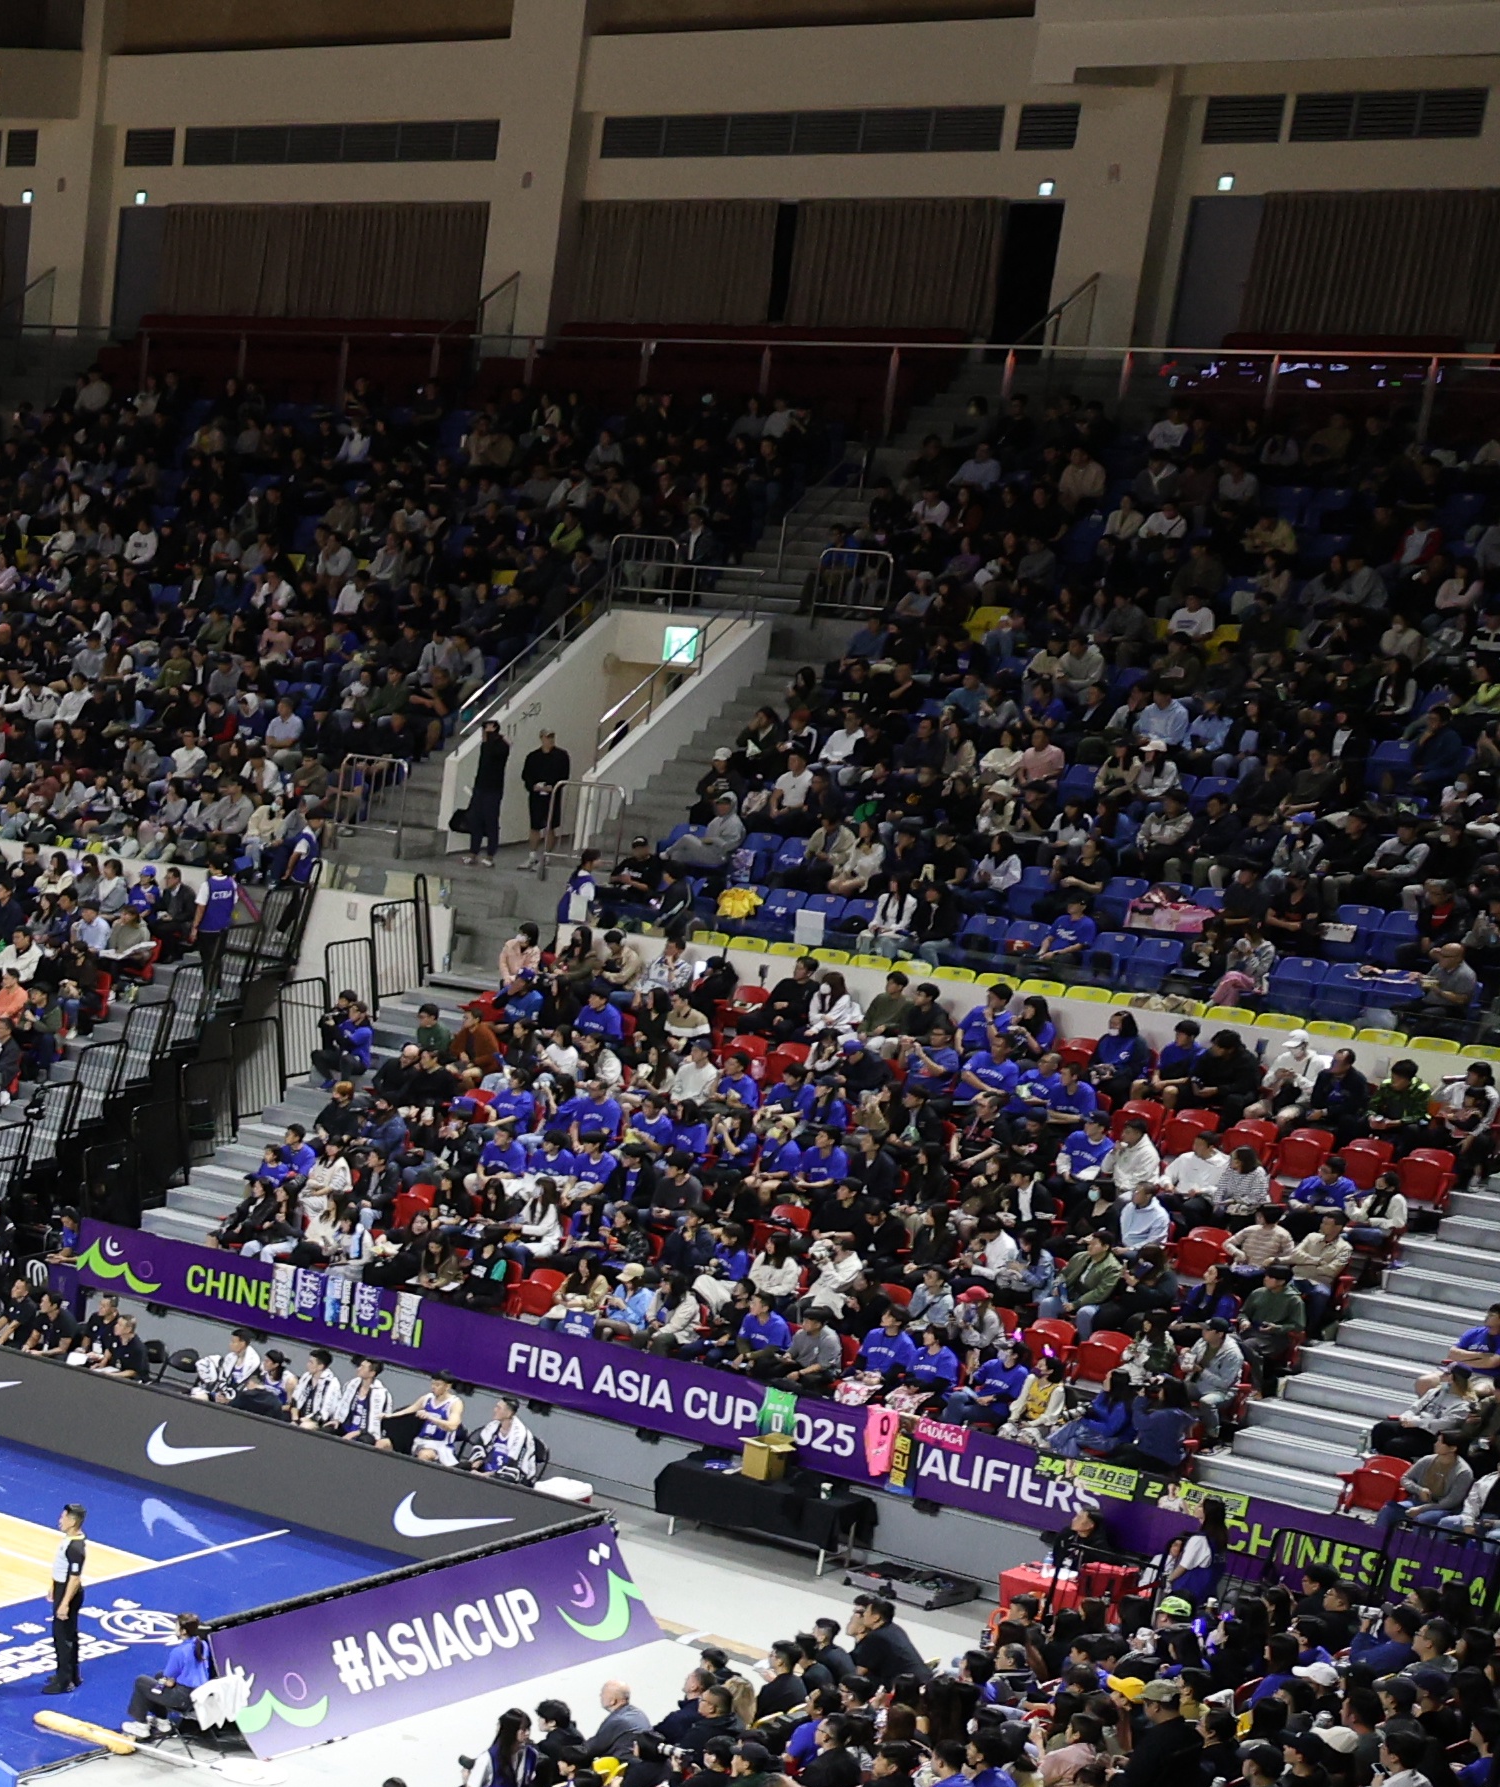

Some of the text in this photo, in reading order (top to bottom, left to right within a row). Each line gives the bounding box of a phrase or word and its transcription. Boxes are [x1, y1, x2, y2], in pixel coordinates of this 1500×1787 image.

[507, 1341, 585, 1390] FIBA
[591, 1363, 674, 1415] ASIA
[682, 1379, 759, 1431] CUP
[792, 1412, 857, 1458] 025
[879, 1415, 891, 1436] 0
[918, 1421, 964, 1446] GADIAGA
[1034, 1455, 1065, 1475] 34
[1143, 1480, 1164, 1499] 2
[1226, 1518, 1422, 1596] CHINESE
[332, 1587, 540, 1695] #ASIACUP
